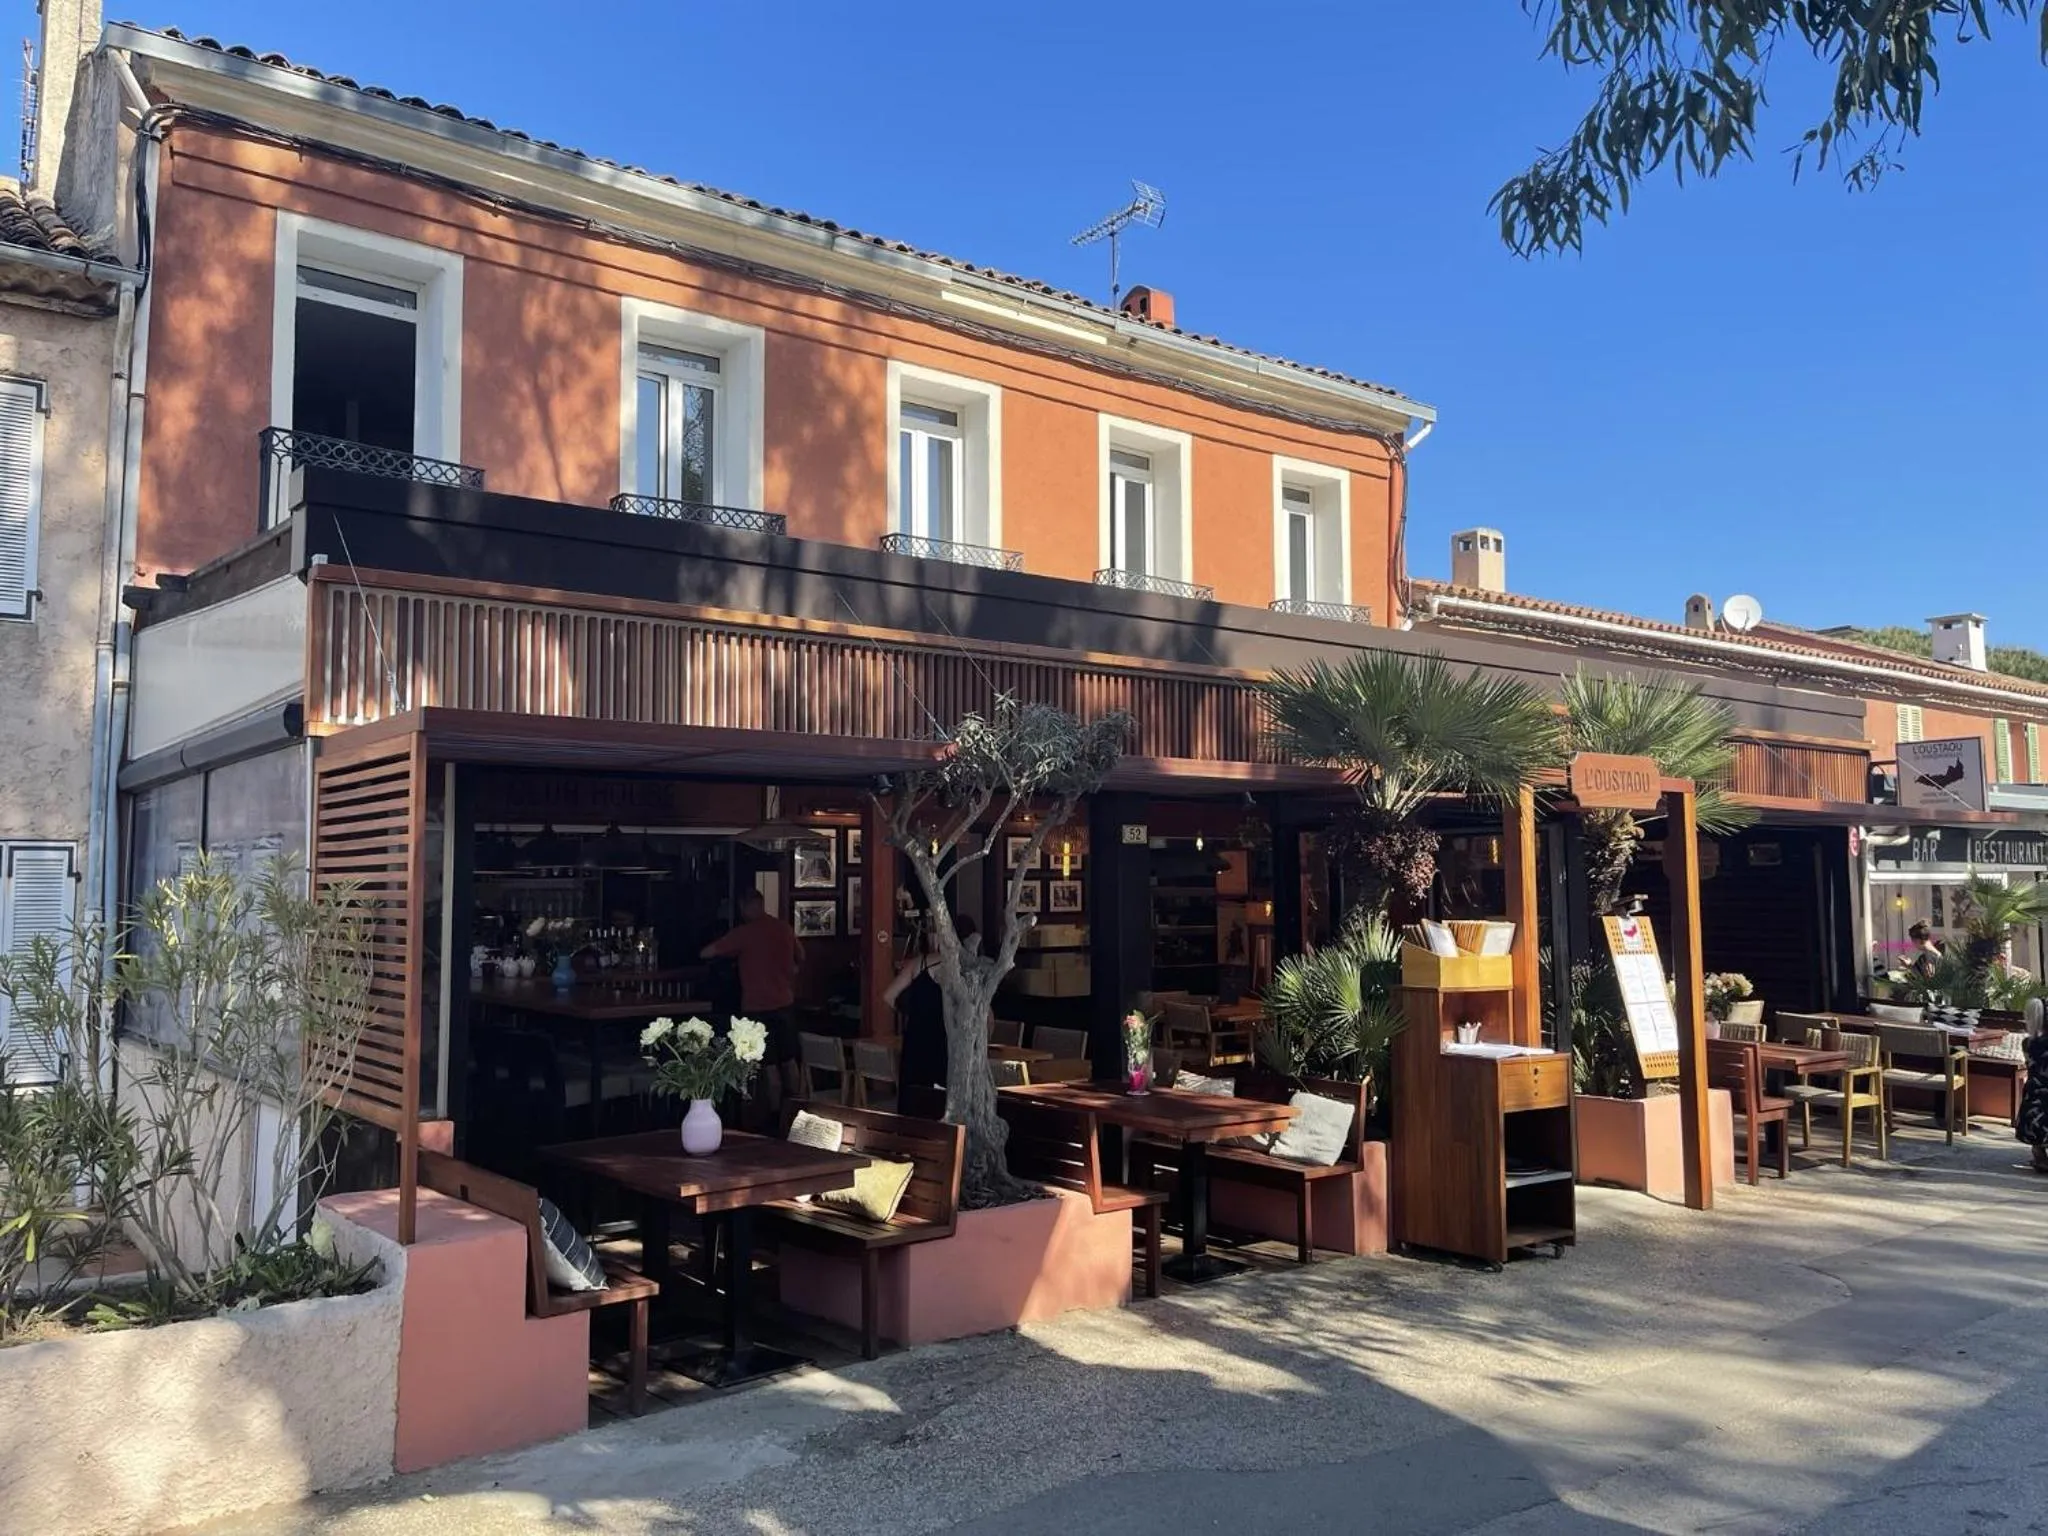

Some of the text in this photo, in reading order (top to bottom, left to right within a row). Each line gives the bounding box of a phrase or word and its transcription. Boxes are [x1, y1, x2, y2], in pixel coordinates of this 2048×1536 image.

[1584, 768, 1649, 792] L'OUSTAOU
[1129, 828, 1141, 840] 52
[1913, 839, 1937, 862] BAR
[1976, 840, 2045, 863] RESTAURANT
